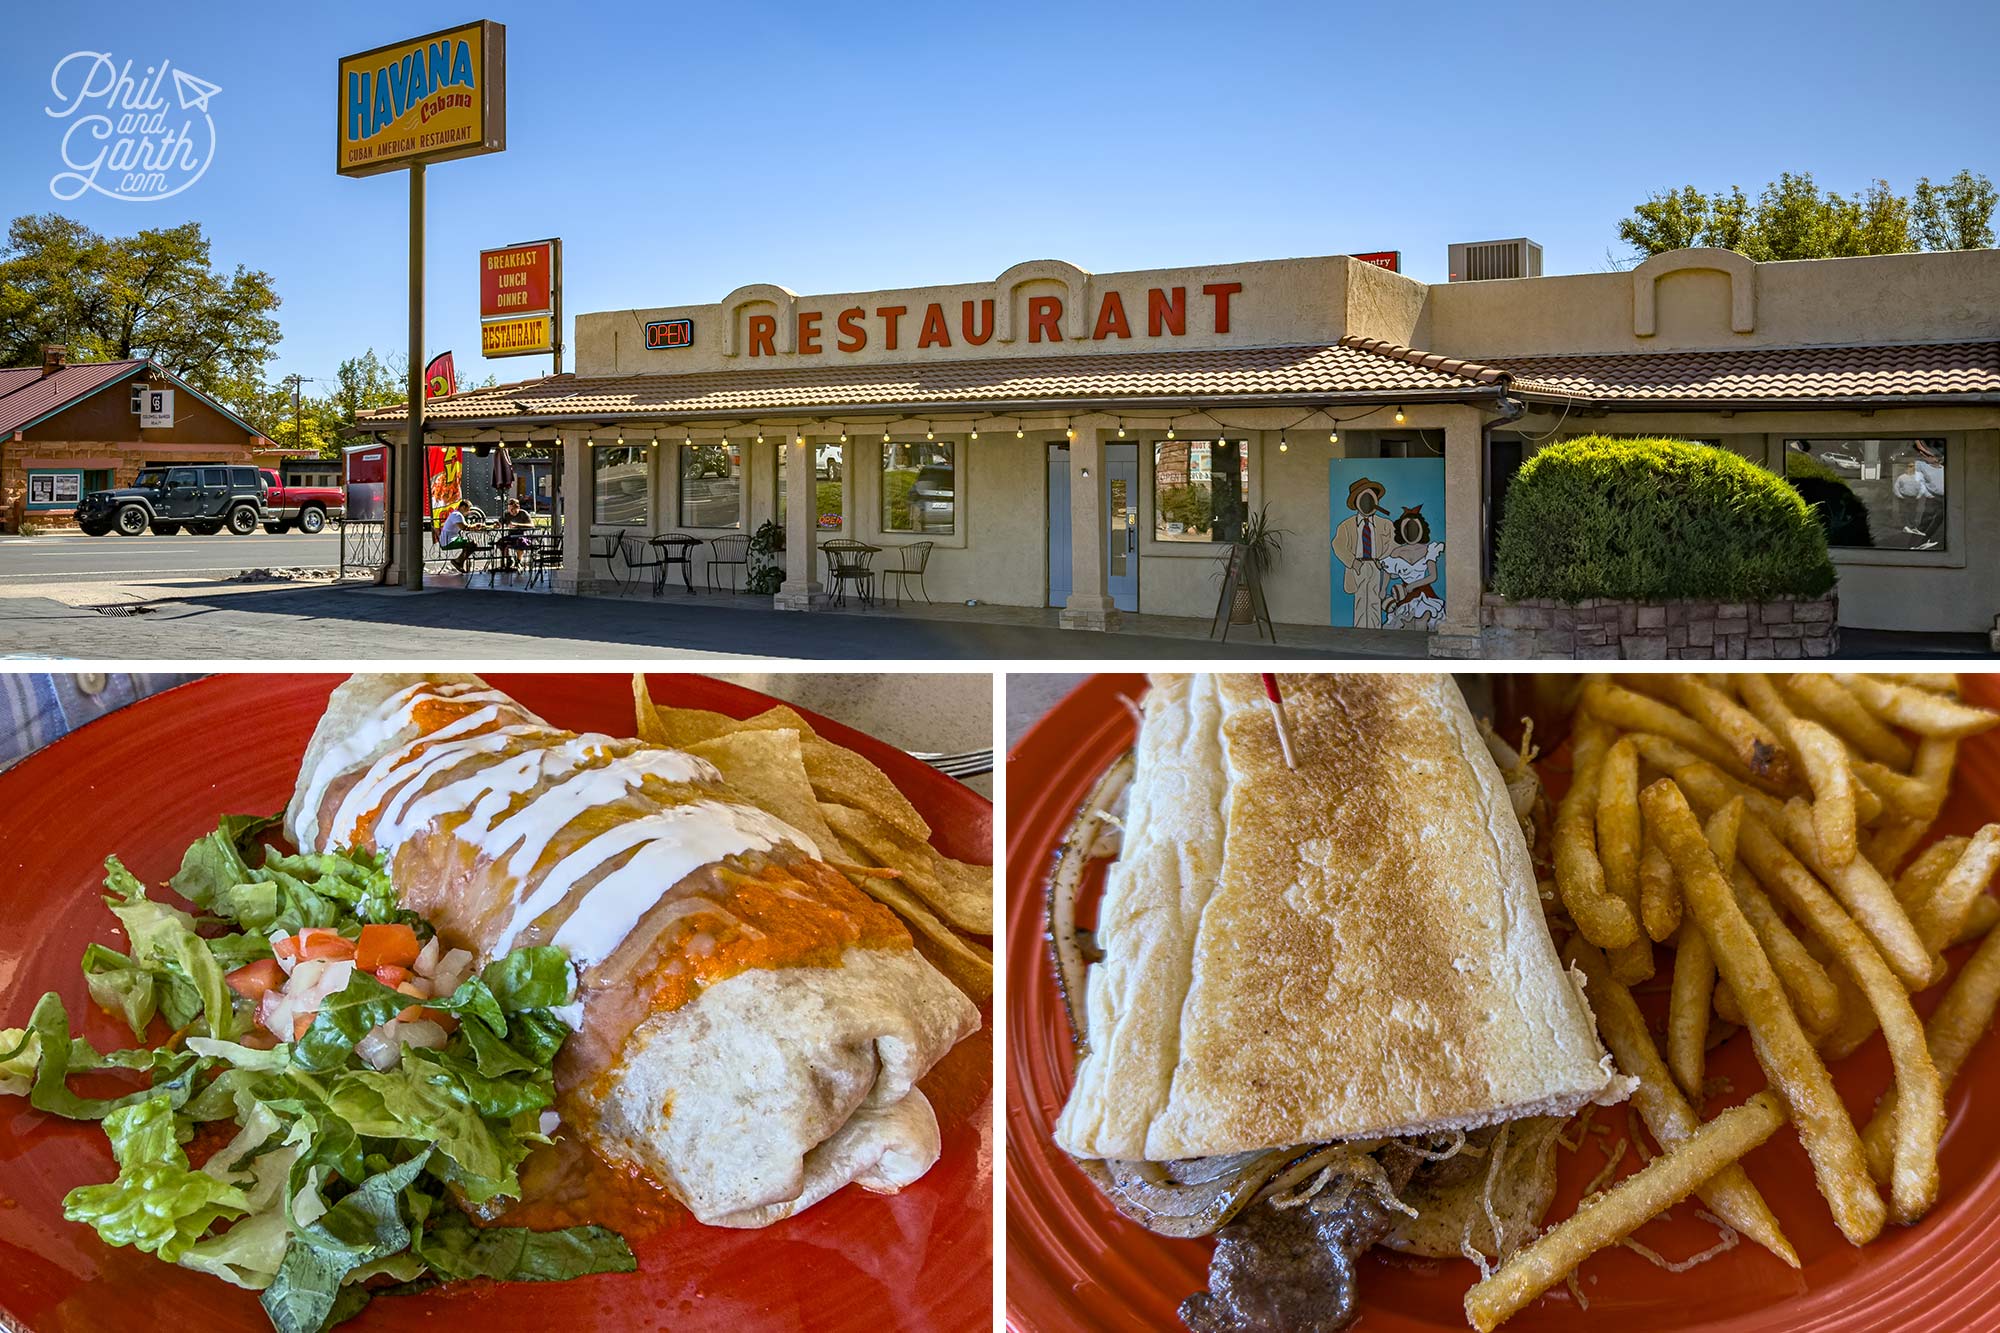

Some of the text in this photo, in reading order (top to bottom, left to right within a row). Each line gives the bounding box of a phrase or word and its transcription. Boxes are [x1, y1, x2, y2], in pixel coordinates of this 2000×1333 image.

[348, 39, 475, 142] HAVANA
[420, 93, 472, 124] Cabana
[348, 126, 472, 162] CUBAN AMERICAN RESTAURANT
[487, 251, 537, 270] BREAKFAST
[499, 272, 527, 288] LUNCH
[497, 291, 528, 307] DINNER
[482, 320, 543, 350] RESTAURANT
[648, 323, 688, 346] OPEN
[748, 283, 1242, 357] RESTAURANT
